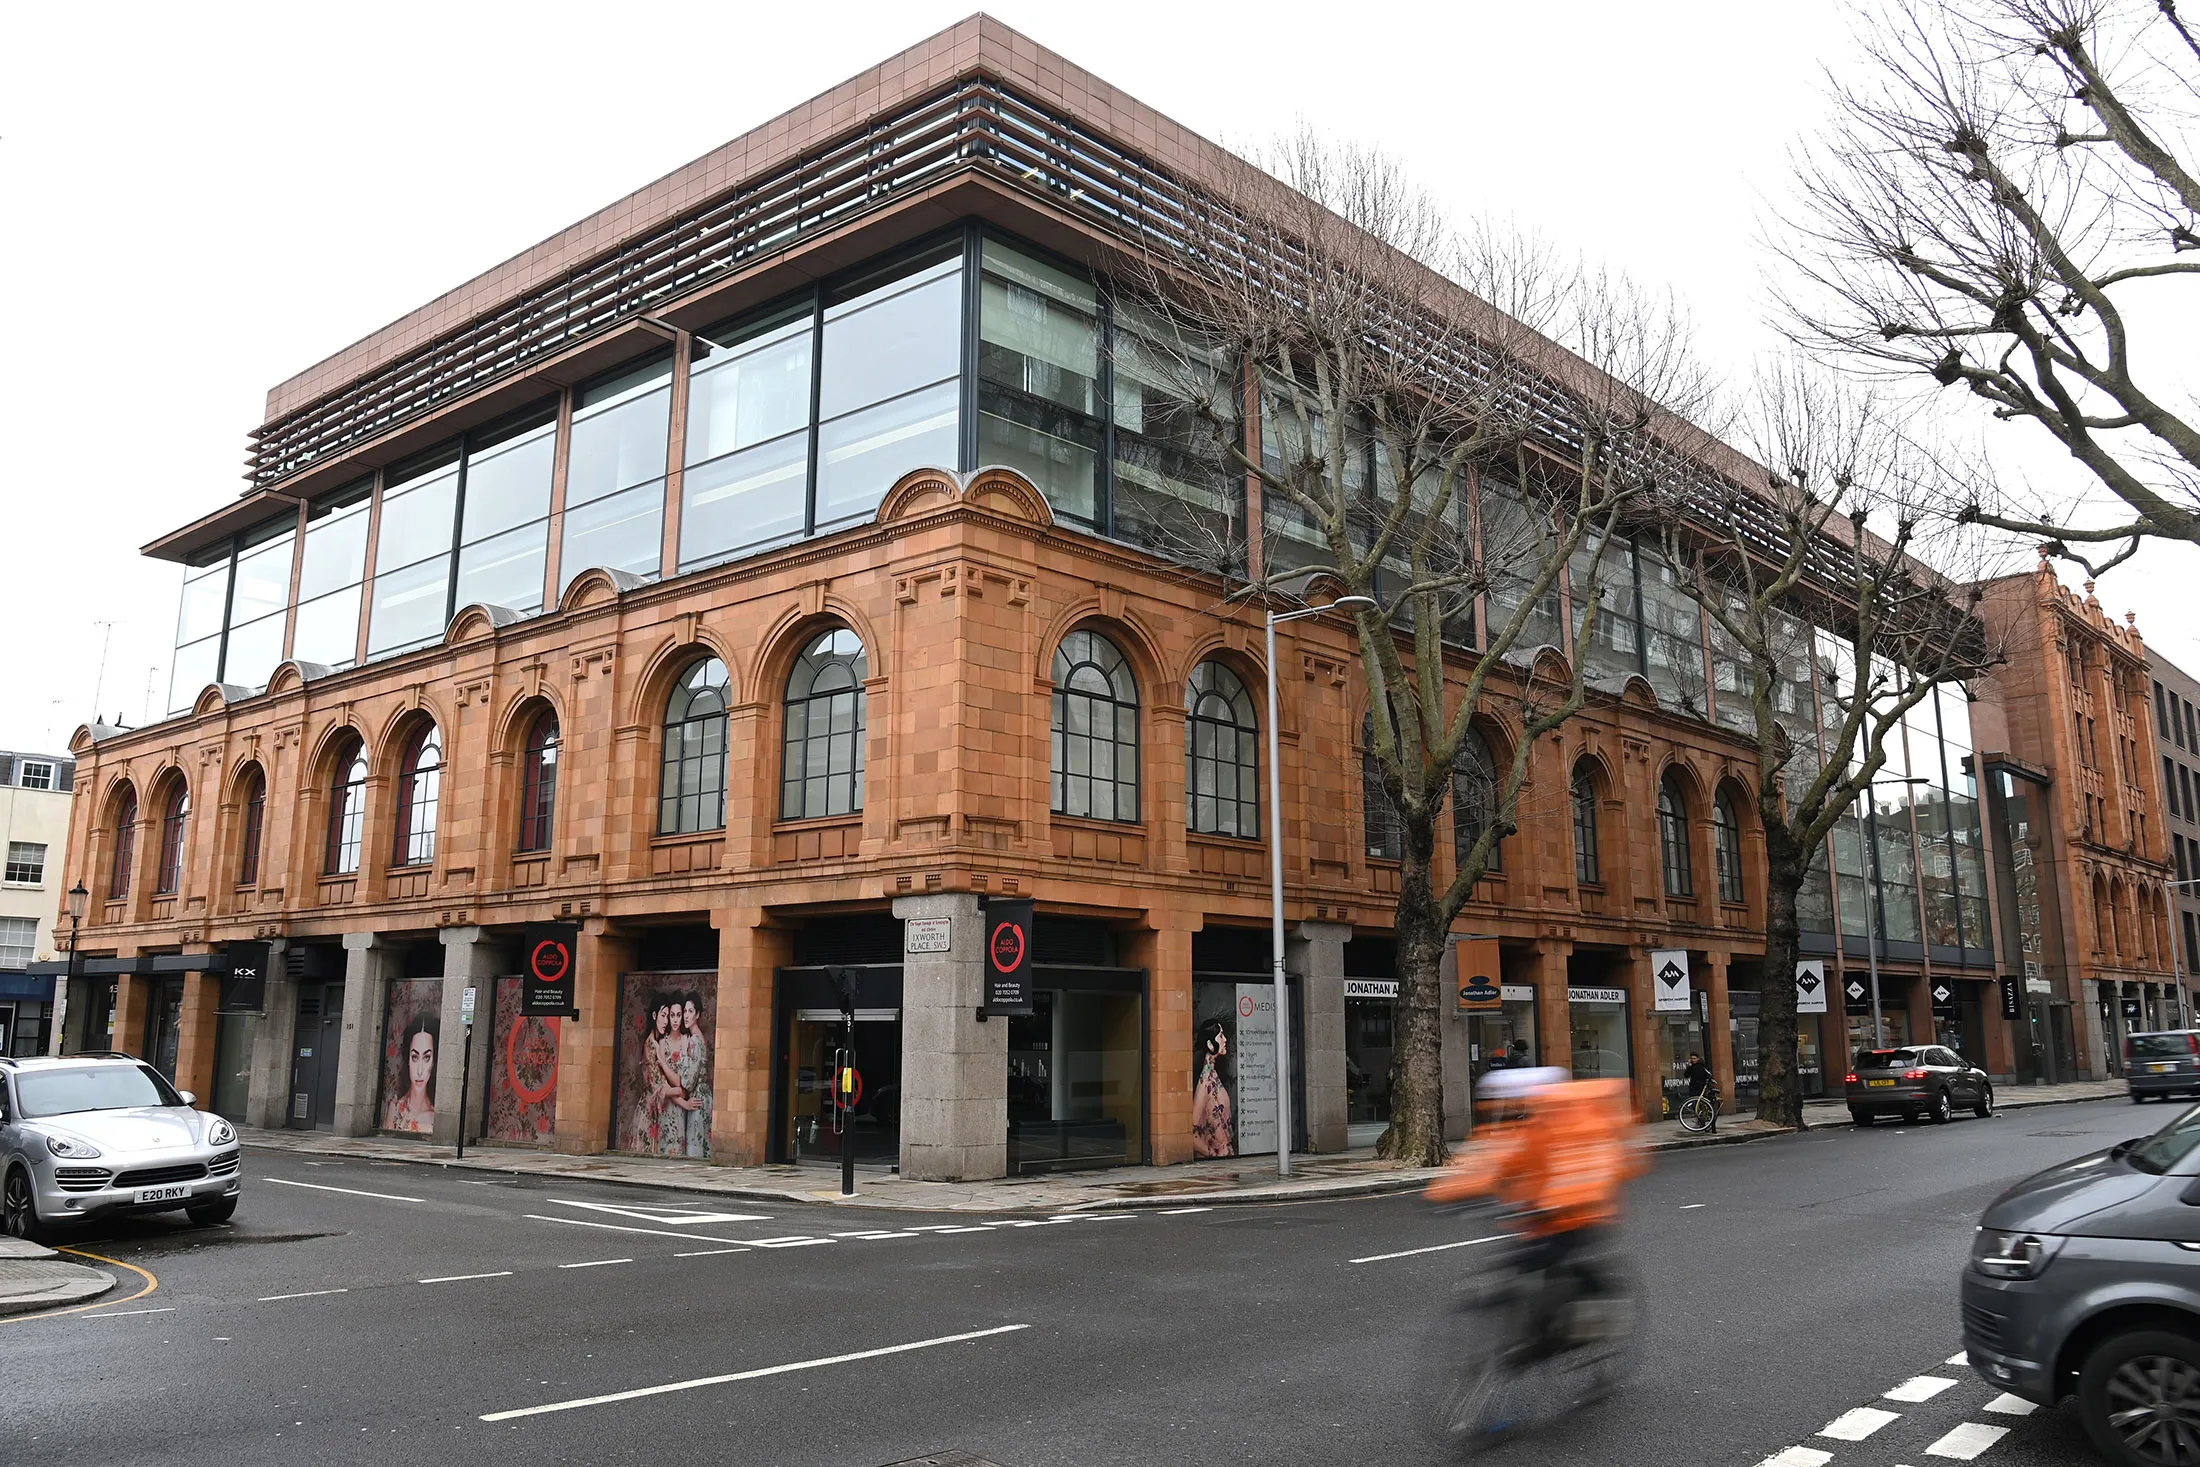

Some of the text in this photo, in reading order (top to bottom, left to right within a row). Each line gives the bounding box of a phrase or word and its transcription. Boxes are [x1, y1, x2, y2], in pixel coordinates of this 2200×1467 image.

[912, 933, 945, 941] IXWORTH
[234, 968, 256, 976] KX
[1347, 982, 1390, 994] JONATHAN
[1568, 990, 1619, 1000] JONATHAN ADLER
[142, 1186, 185, 1201] E20 RKY
